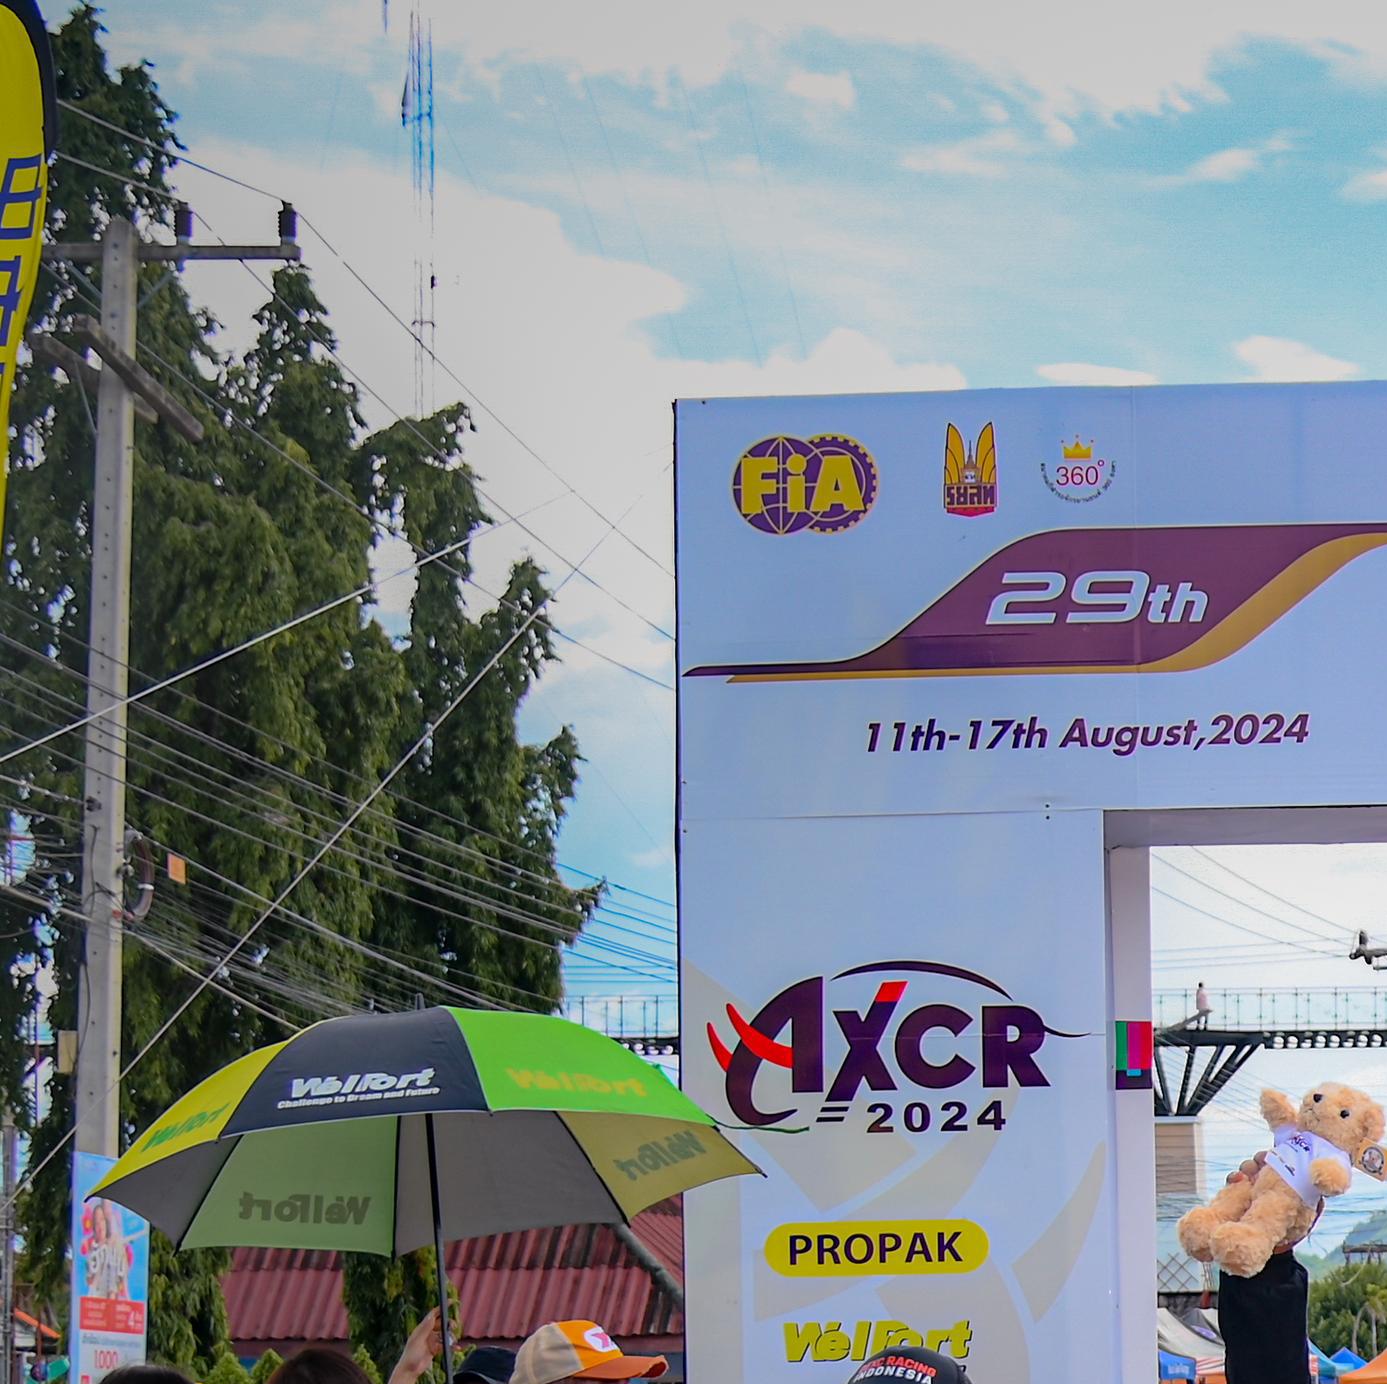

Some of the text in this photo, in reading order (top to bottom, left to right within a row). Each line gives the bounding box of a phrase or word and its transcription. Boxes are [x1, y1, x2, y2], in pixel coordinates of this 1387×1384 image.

[984, 569, 1210, 626] 29th
[864, 712, 1310, 758] 11th-17th August,2024
[720, 976, 1056, 1126] AXCR
[278, 1085, 441, 1109] Challenge to Dream and Future
[866, 1100, 1007, 1133] 2024
[789, 1231, 964, 1266] PROPAK
[886, 1355, 938, 1377] RACING
